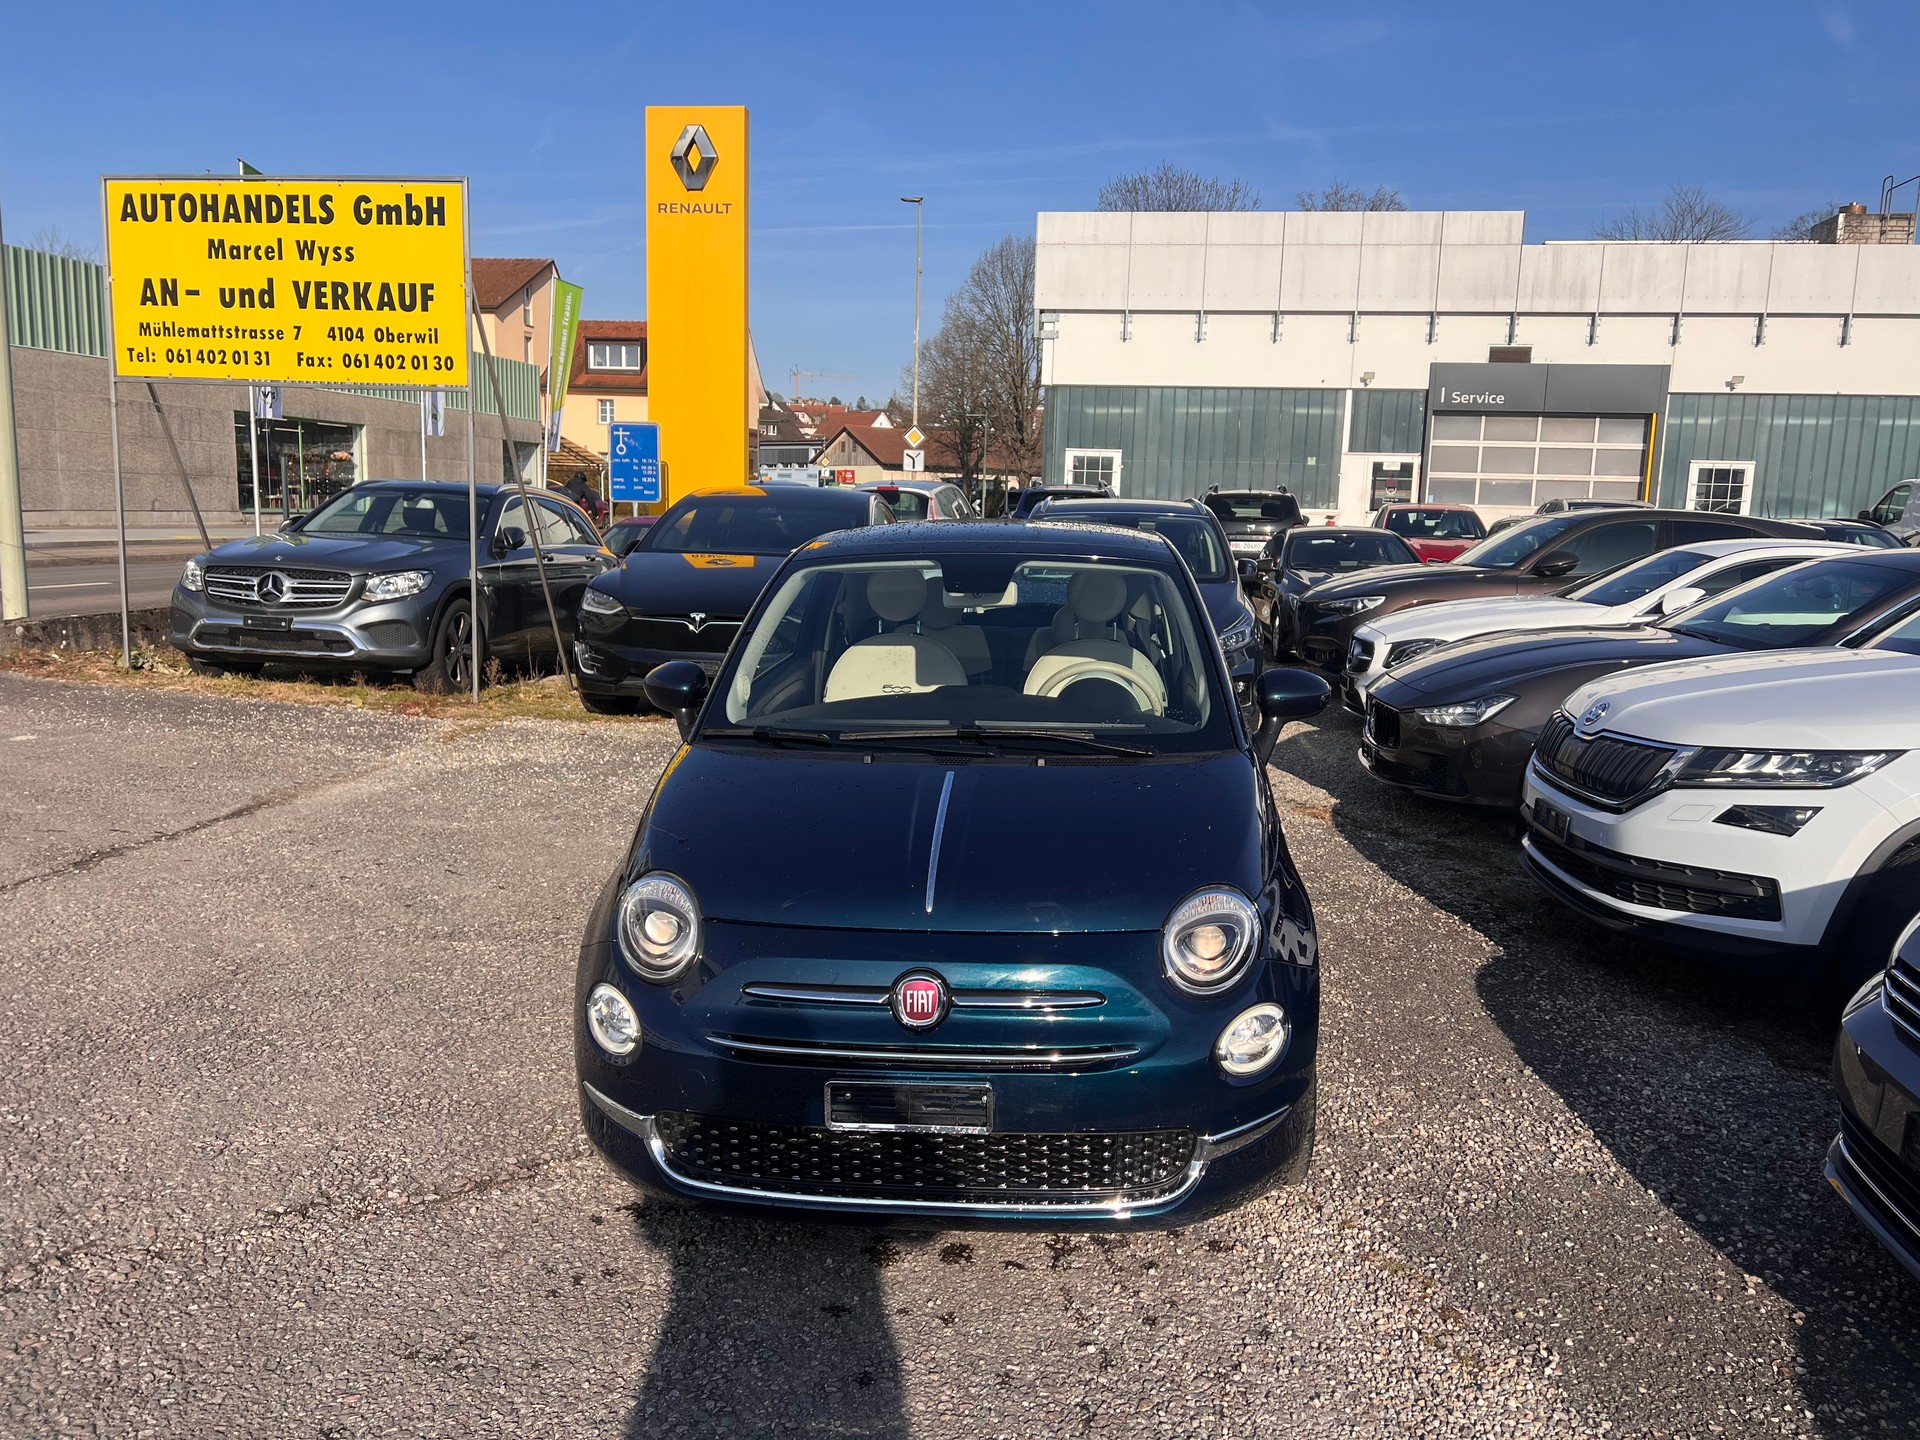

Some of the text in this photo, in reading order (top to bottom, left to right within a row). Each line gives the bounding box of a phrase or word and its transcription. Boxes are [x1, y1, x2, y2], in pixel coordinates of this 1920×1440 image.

[120, 192, 446, 227] AUTOHANDELS GmbH
[657, 202, 733, 214] RENAULT
[207, 237, 355, 267] Marcel Wyss
[139, 277, 435, 313] AN- und VERKAUF
[562, 292, 573, 326] Traum.
[139, 321, 439, 344] Mühlemattstrasse 7 4104 Oberwil
[558, 329, 568, 362] deinen
[126, 347, 157, 362] Tel:
[296, 351, 332, 368] Fax:
[1451, 391, 1505, 404] Service
[882, 684, 912, 693] 500
[906, 990, 935, 1013] FIAT
